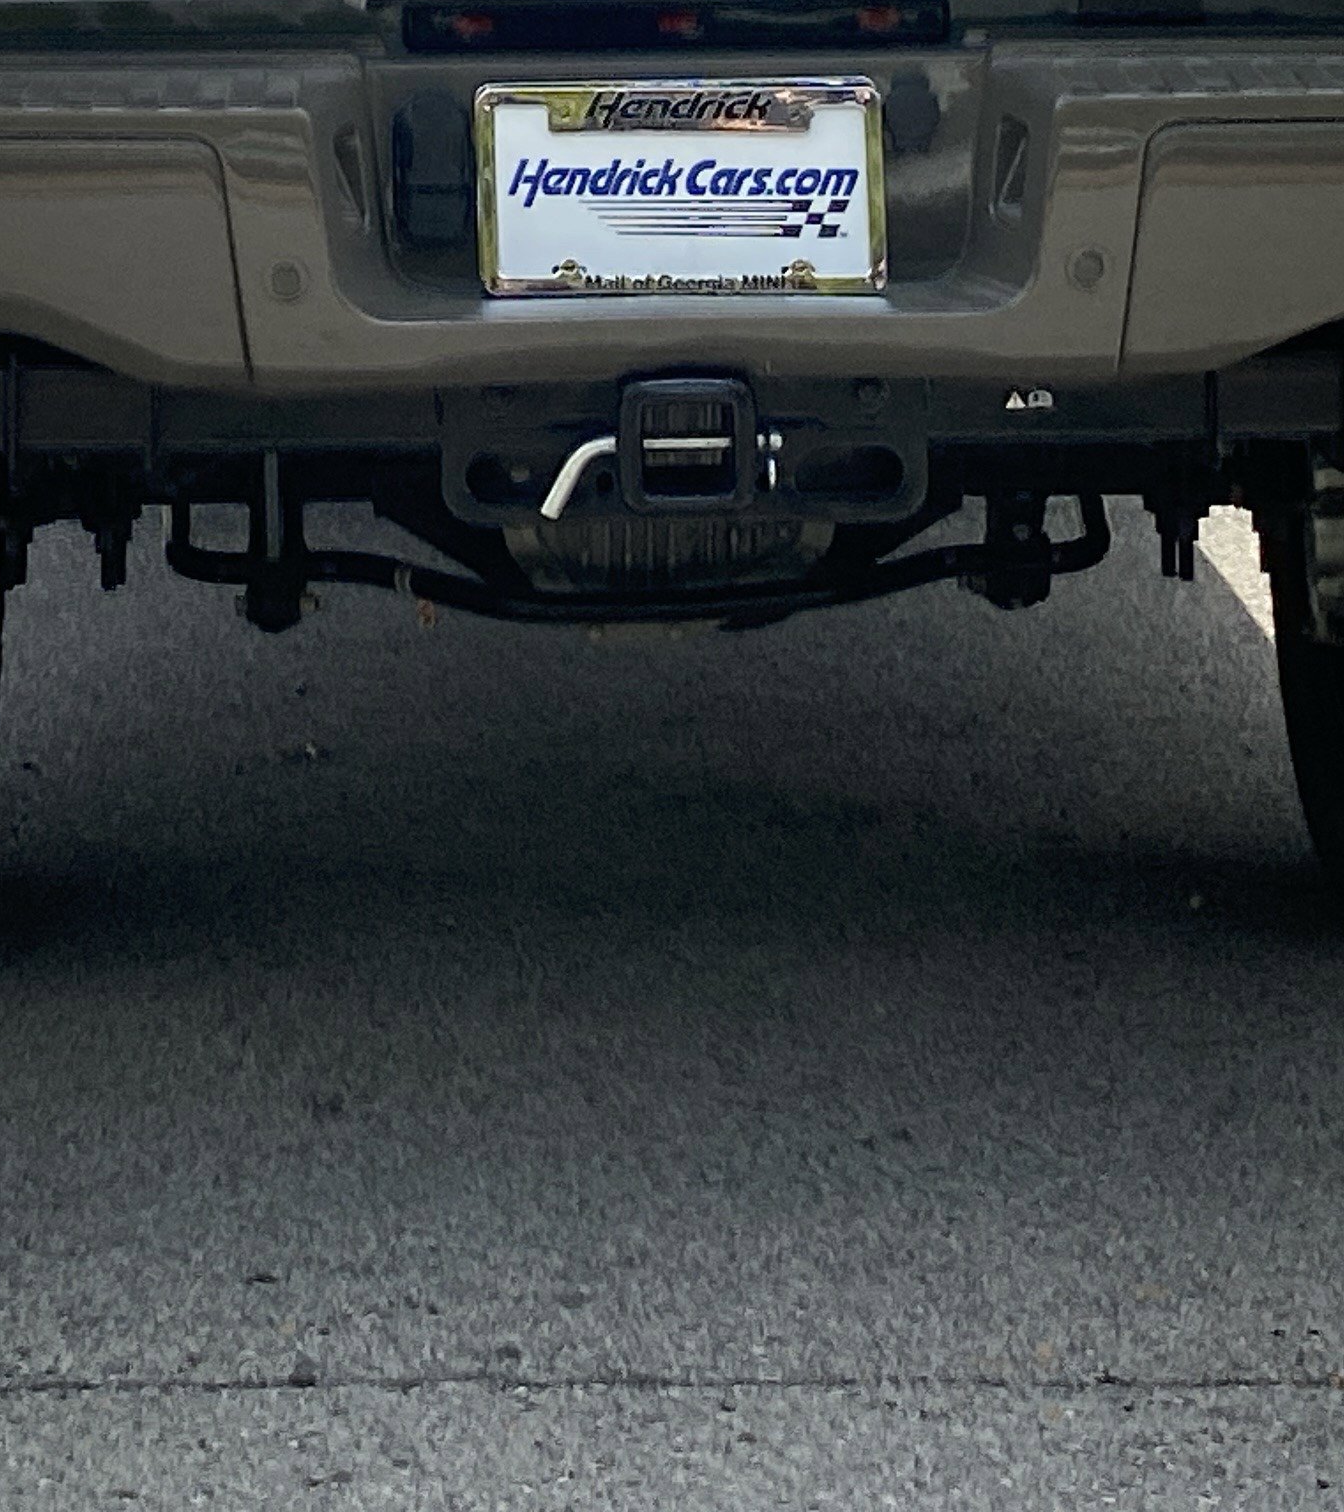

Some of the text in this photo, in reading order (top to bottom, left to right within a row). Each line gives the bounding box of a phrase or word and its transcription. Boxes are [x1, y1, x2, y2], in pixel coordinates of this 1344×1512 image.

[585, 89, 772, 129] Hendrick
[585, 274, 625, 289] Mall
[657, 274, 736, 293] Georgia
